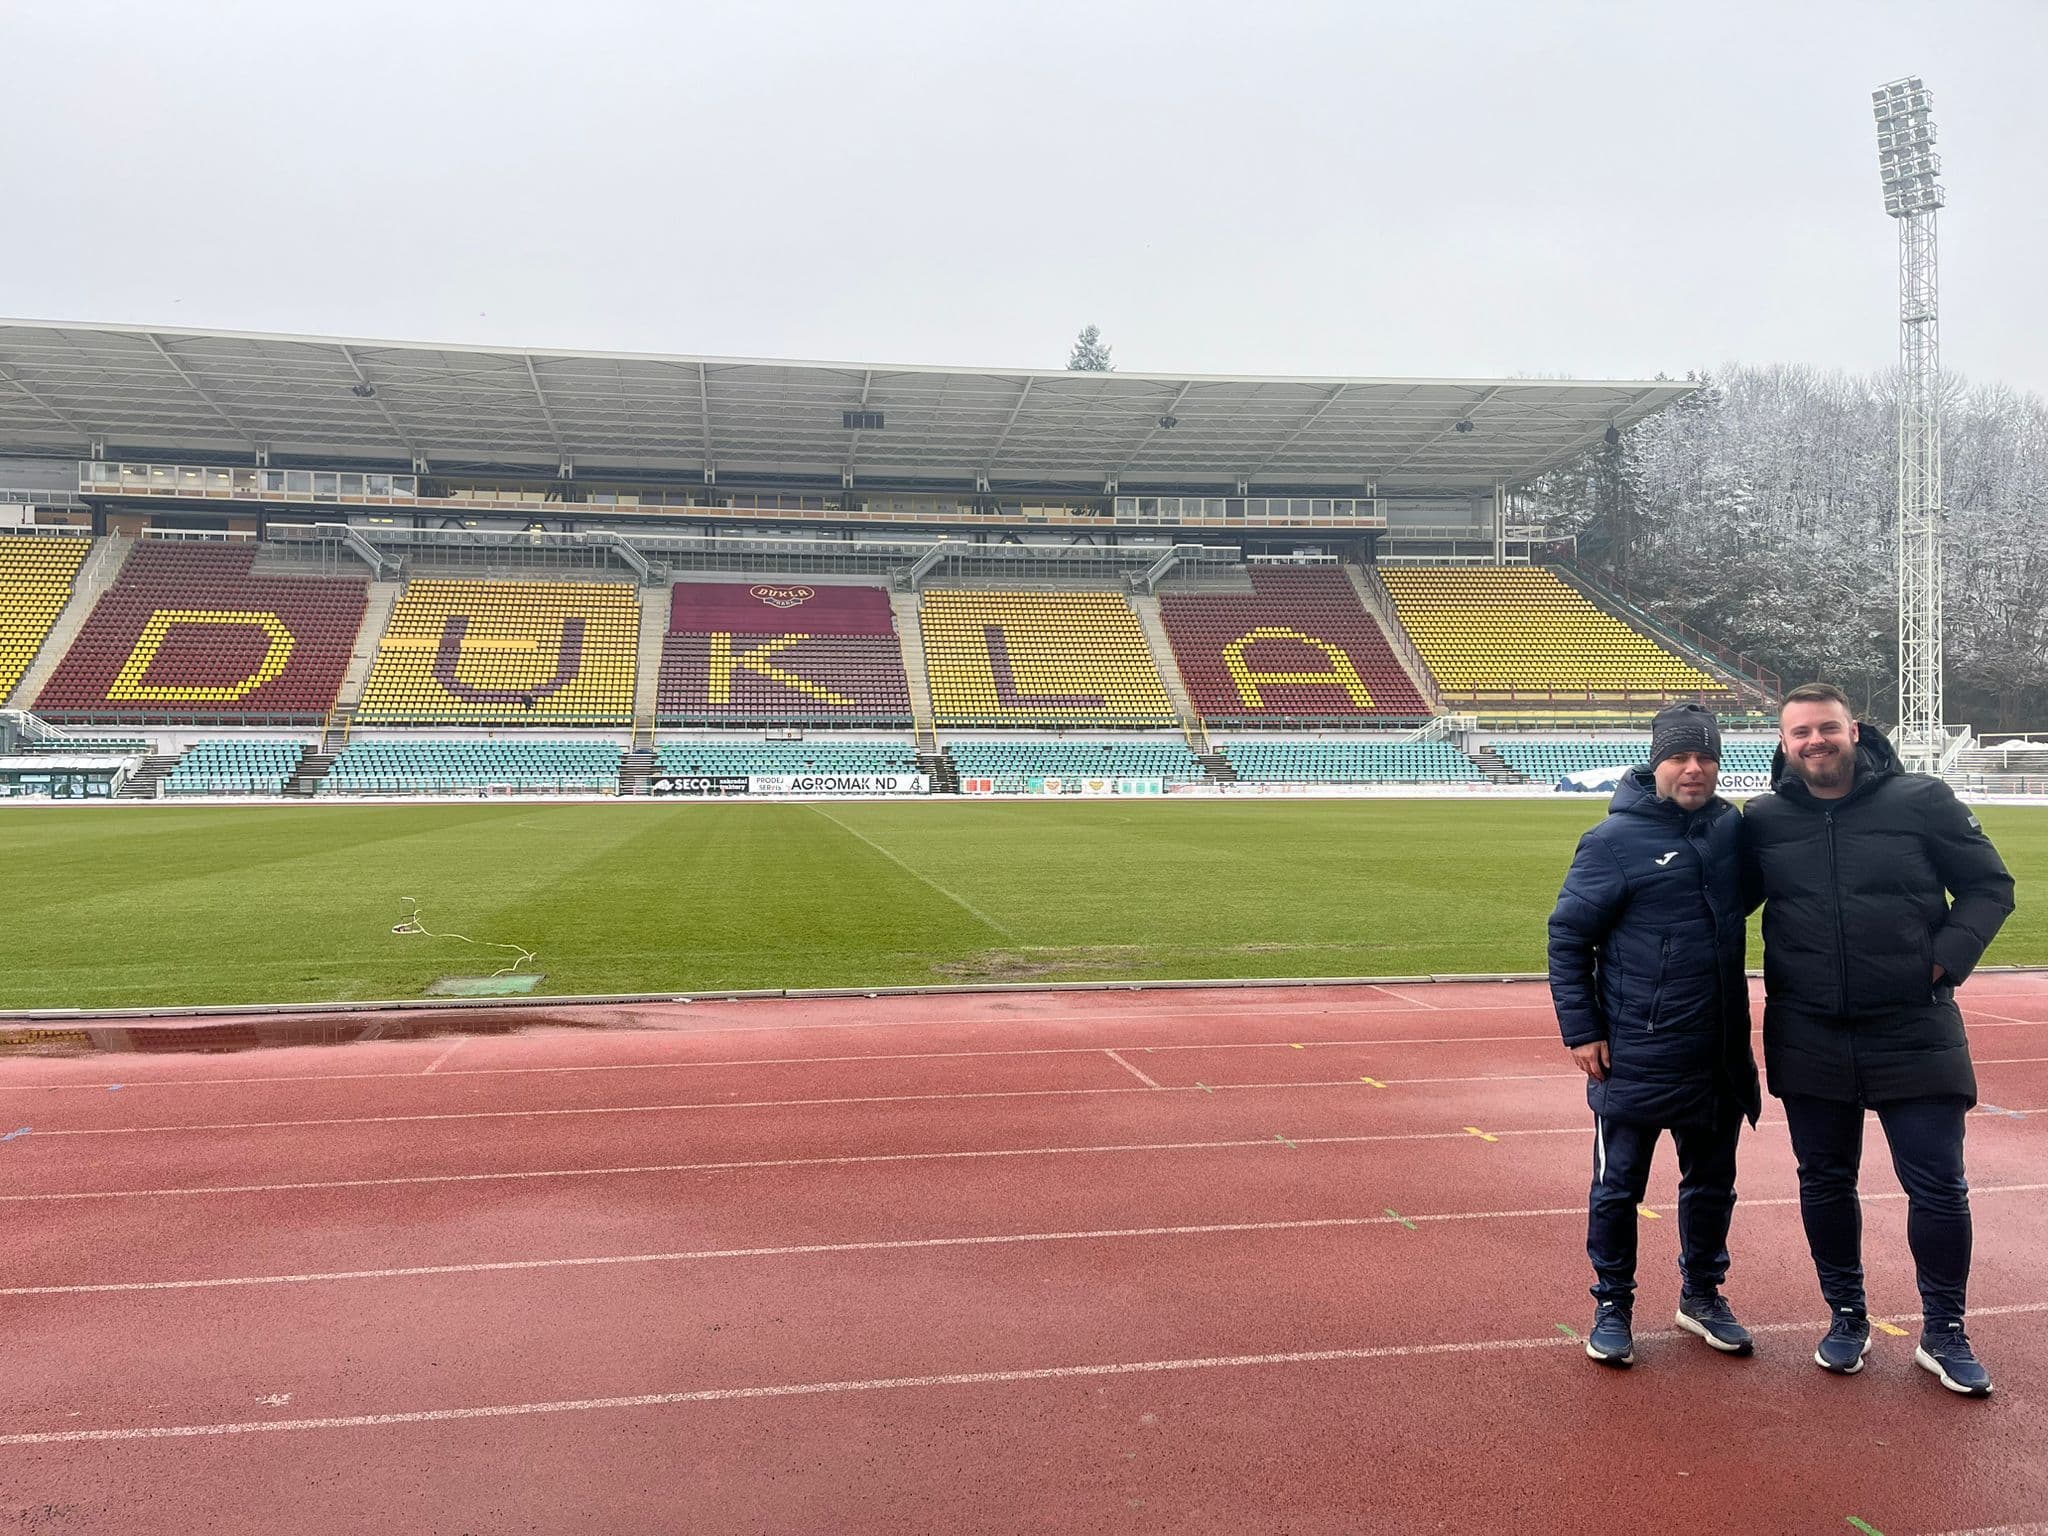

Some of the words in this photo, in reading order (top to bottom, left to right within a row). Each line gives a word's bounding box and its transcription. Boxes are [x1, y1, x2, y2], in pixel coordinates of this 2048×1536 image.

[758, 588, 809, 597] DUKLA
[674, 778, 711, 790] SECO
[791, 777, 870, 790] AGROMAK
